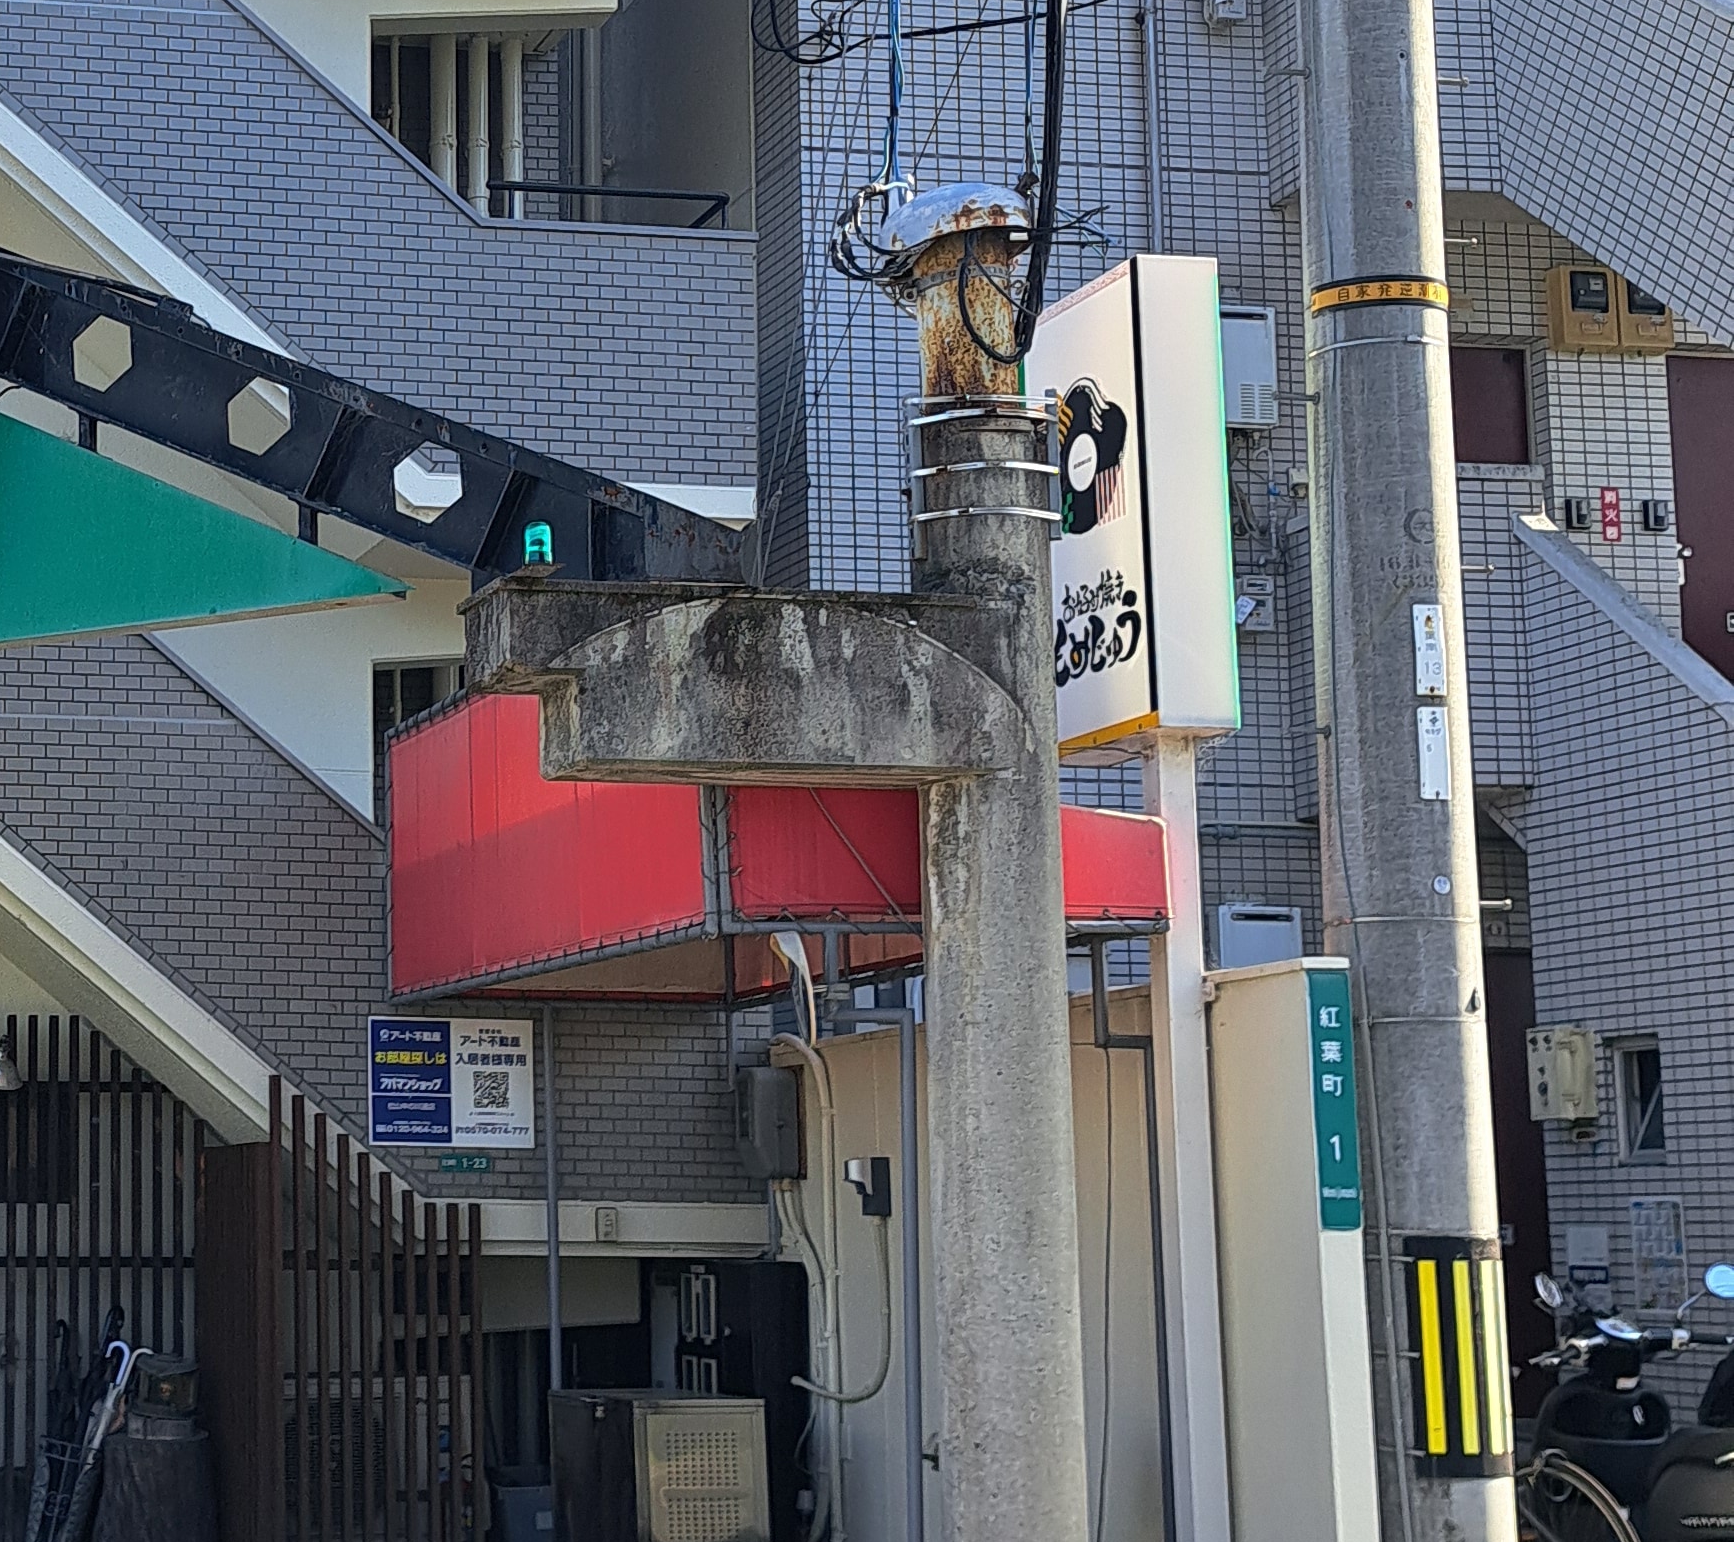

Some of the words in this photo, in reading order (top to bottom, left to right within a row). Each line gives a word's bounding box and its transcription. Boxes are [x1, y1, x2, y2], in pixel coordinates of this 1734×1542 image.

[1062, 569, 1124, 624] お好み焼き
[1424, 661, 1442, 676] 13
[455, 1052, 528, 1067] 入居者様専用
[1319, 1005, 1344, 1097] 紅葉町
[1329, 1134, 1342, 1163] 1
[461, 1157, 488, 1169] 1-23
